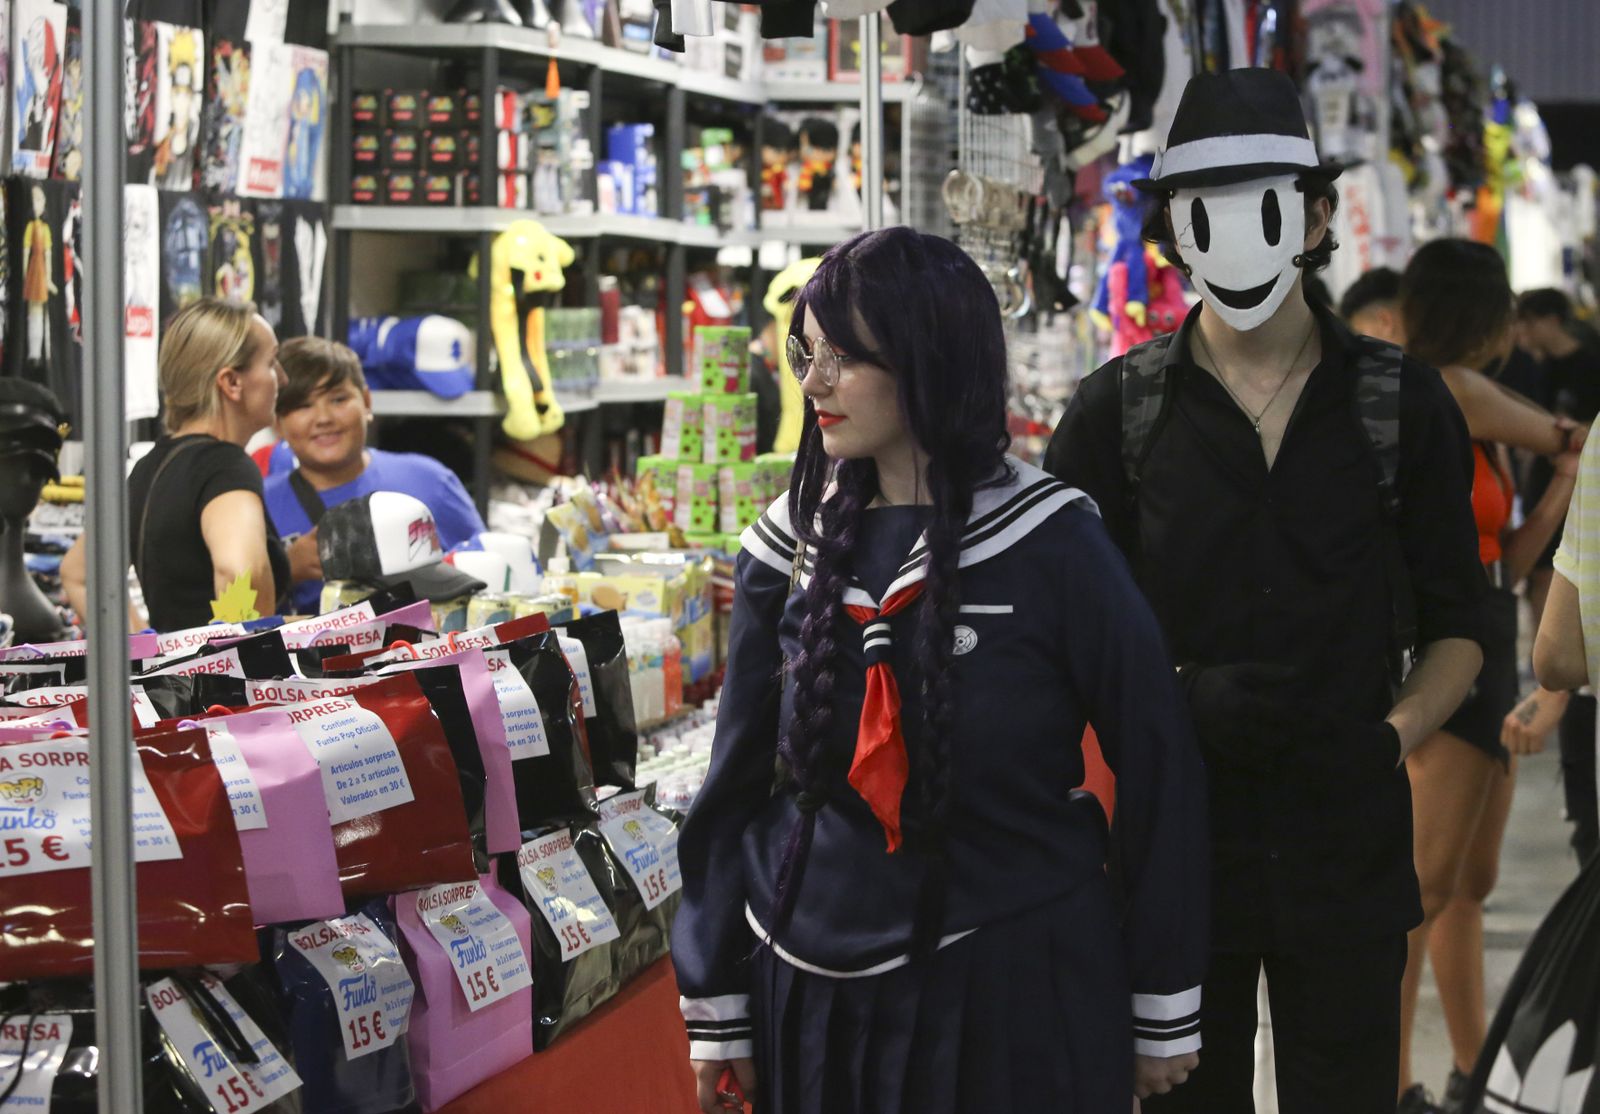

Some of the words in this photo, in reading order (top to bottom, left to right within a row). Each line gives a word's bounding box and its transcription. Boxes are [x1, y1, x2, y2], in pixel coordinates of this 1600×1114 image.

[252, 687, 307, 702] BOLSA
[336, 780, 347, 790] De
[41, 836, 70, 861] €
[450, 935, 487, 969] Funko
[561, 924, 581, 953] 15
[338, 973, 377, 1012] Funko
[467, 970, 487, 1002] 15
[486, 965, 500, 993] €
[349, 1016, 371, 1050] 15
[373, 1010, 386, 1041] €
[217, 1076, 250, 1114] 15
